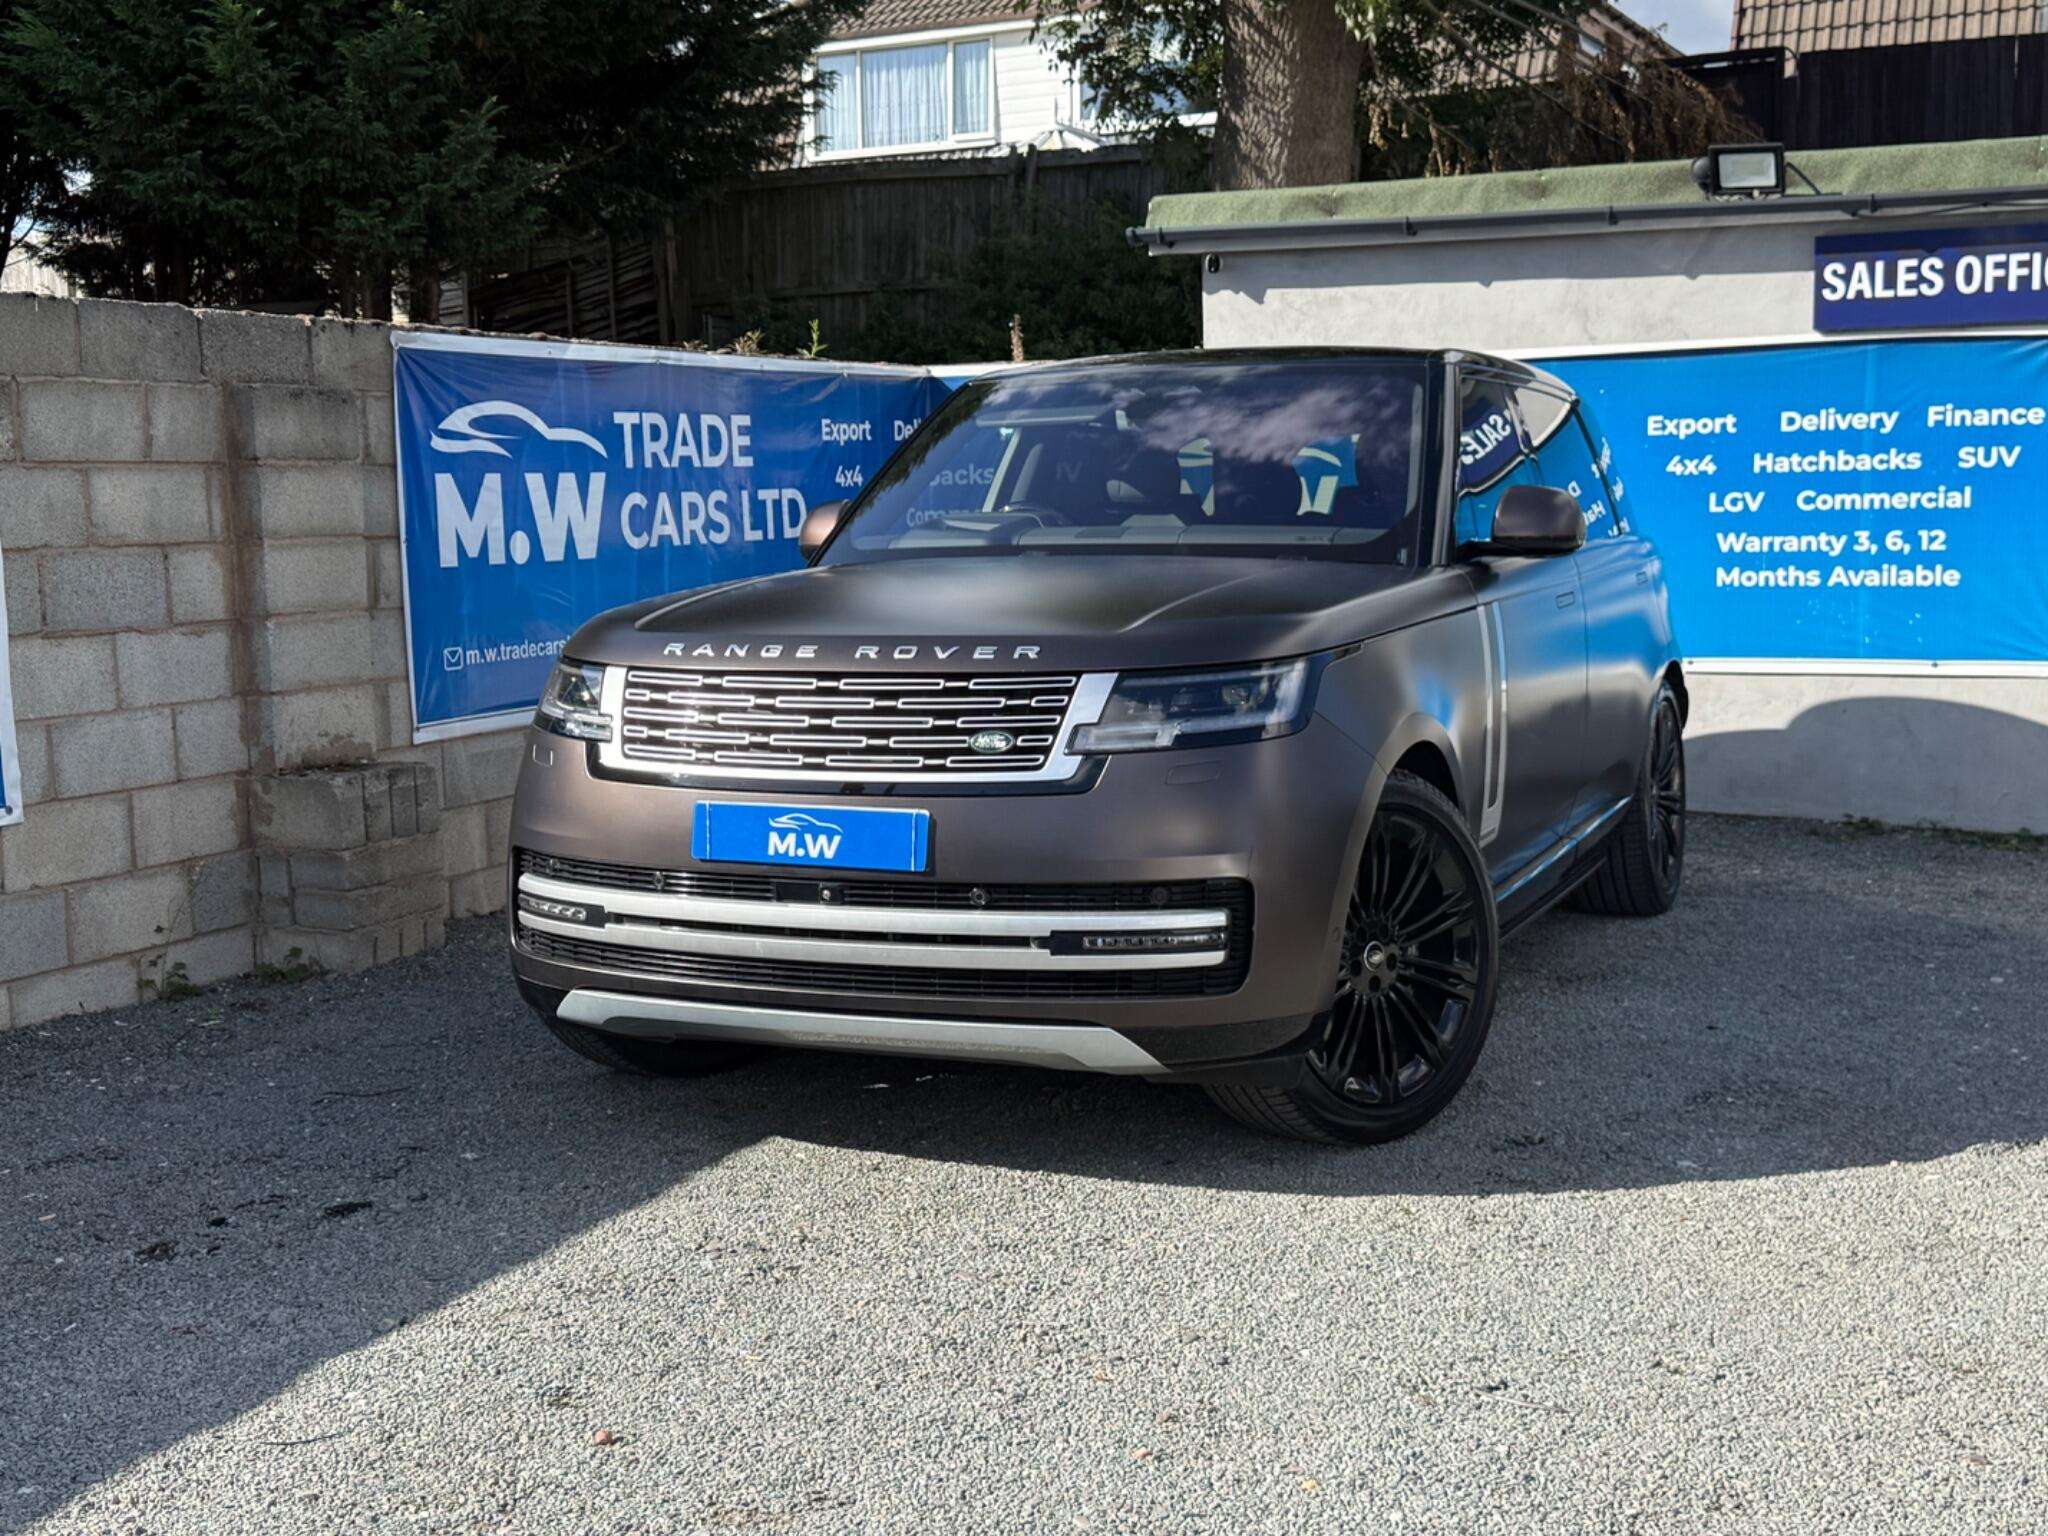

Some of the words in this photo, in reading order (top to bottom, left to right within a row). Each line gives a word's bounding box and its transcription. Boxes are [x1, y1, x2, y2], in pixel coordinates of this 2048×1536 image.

[1822, 256, 1945, 301] SALES
[1955, 251, 2048, 295] OFFI
[821, 418, 872, 446] Export
[1647, 414, 1738, 440] Export
[1780, 407, 1900, 434] Delivery
[1927, 402, 2047, 428] Finance
[613, 411, 754, 468] TRADE
[1665, 454, 1718, 476] 4x4
[1753, 447, 1923, 474] Hatchbacks
[1958, 445, 2022, 468] SUV
[835, 465, 863, 487] 4x4
[1708, 491, 1765, 513] LGV
[1796, 485, 1972, 511] Commercial
[434, 471, 607, 568] M.W
[620, 490, 731, 550] CARS
[741, 488, 807, 541] LTD
[1716, 531, 1848, 557] Warranty
[1852, 530, 1878, 555] 3,
[1885, 530, 1911, 555] 6,
[1917, 529, 1947, 551] 12
[1716, 565, 1822, 588] Months
[1826, 563, 1962, 588] Available
[465, 635, 571, 666] m.w.tradecars
[662, 643, 819, 658] RANGE
[854, 645, 1042, 660] ROVER
[767, 831, 842, 859] M.W
